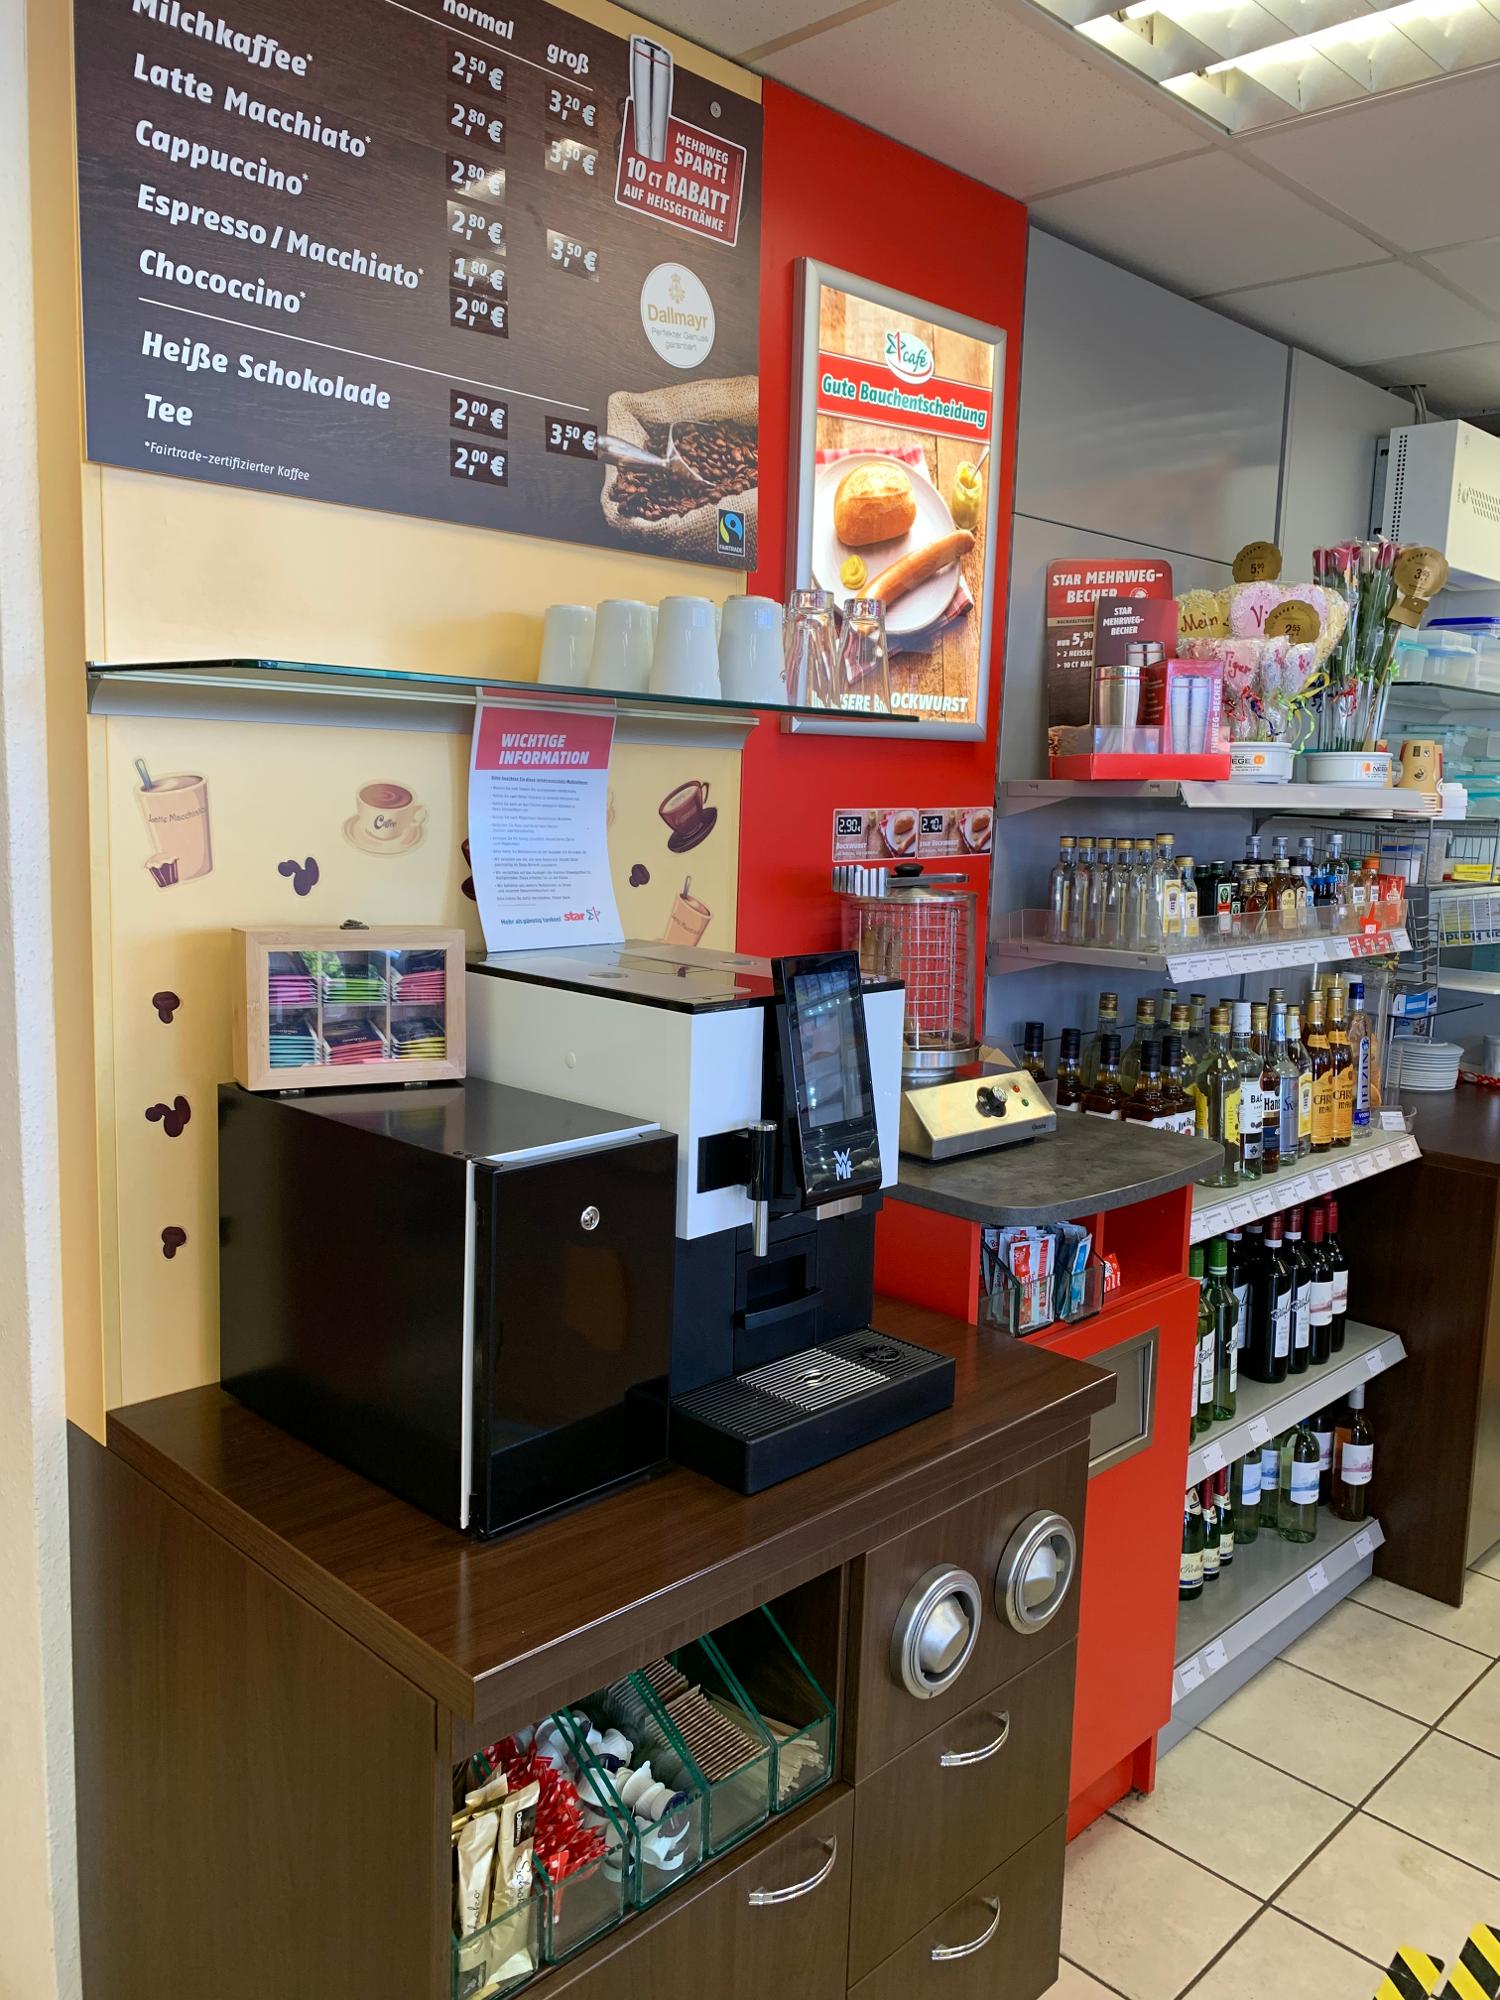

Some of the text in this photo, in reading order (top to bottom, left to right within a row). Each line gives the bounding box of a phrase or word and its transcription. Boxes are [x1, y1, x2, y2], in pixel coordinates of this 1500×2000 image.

[442, 0, 514, 40] normal
[546, 43, 589, 75] groß
[134, 53, 213, 103] Latte
[488, 68, 504, 91] €
[582, 104, 596, 126] €
[487, 120, 503, 143] €
[676, 132, 729, 164] MEHRWEG
[582, 154, 596, 176] €
[674, 149, 727, 185] SPART!
[623, 184, 645, 201] AUF
[626, 157, 730, 214] 10 CT RABATT
[137, 184, 267, 245] Espresso
[487, 222, 503, 245] €
[584, 249, 597, 272] €
[490, 268, 504, 292] €
[491, 306, 505, 329] €
[647, 304, 708, 331] Dallmayr
[141, 330, 391, 410] Heiße Schokolade
[902, 349, 927, 372] café
[144, 393, 193, 427] Tee
[823, 375, 987, 428] Gute Bauchentscheidung
[490, 407, 505, 430] €
[277, 465, 311, 482] Kaffee
[490, 455, 505, 478] €
[1052, 569, 1163, 586] STAR MEHRWEG-
[1066, 588, 1118, 604] BECHER
[1102, 616, 1144, 626] MEHRWEG-
[1114, 607, 1132, 616] STAR
[1111, 626, 1138, 636] BECHER
[501, 733, 566, 748] WICHTIGE
[499, 751, 589, 765] INFORMATION
[564, 911, 585, 922] star
[833, 1147, 851, 1181] WMF
